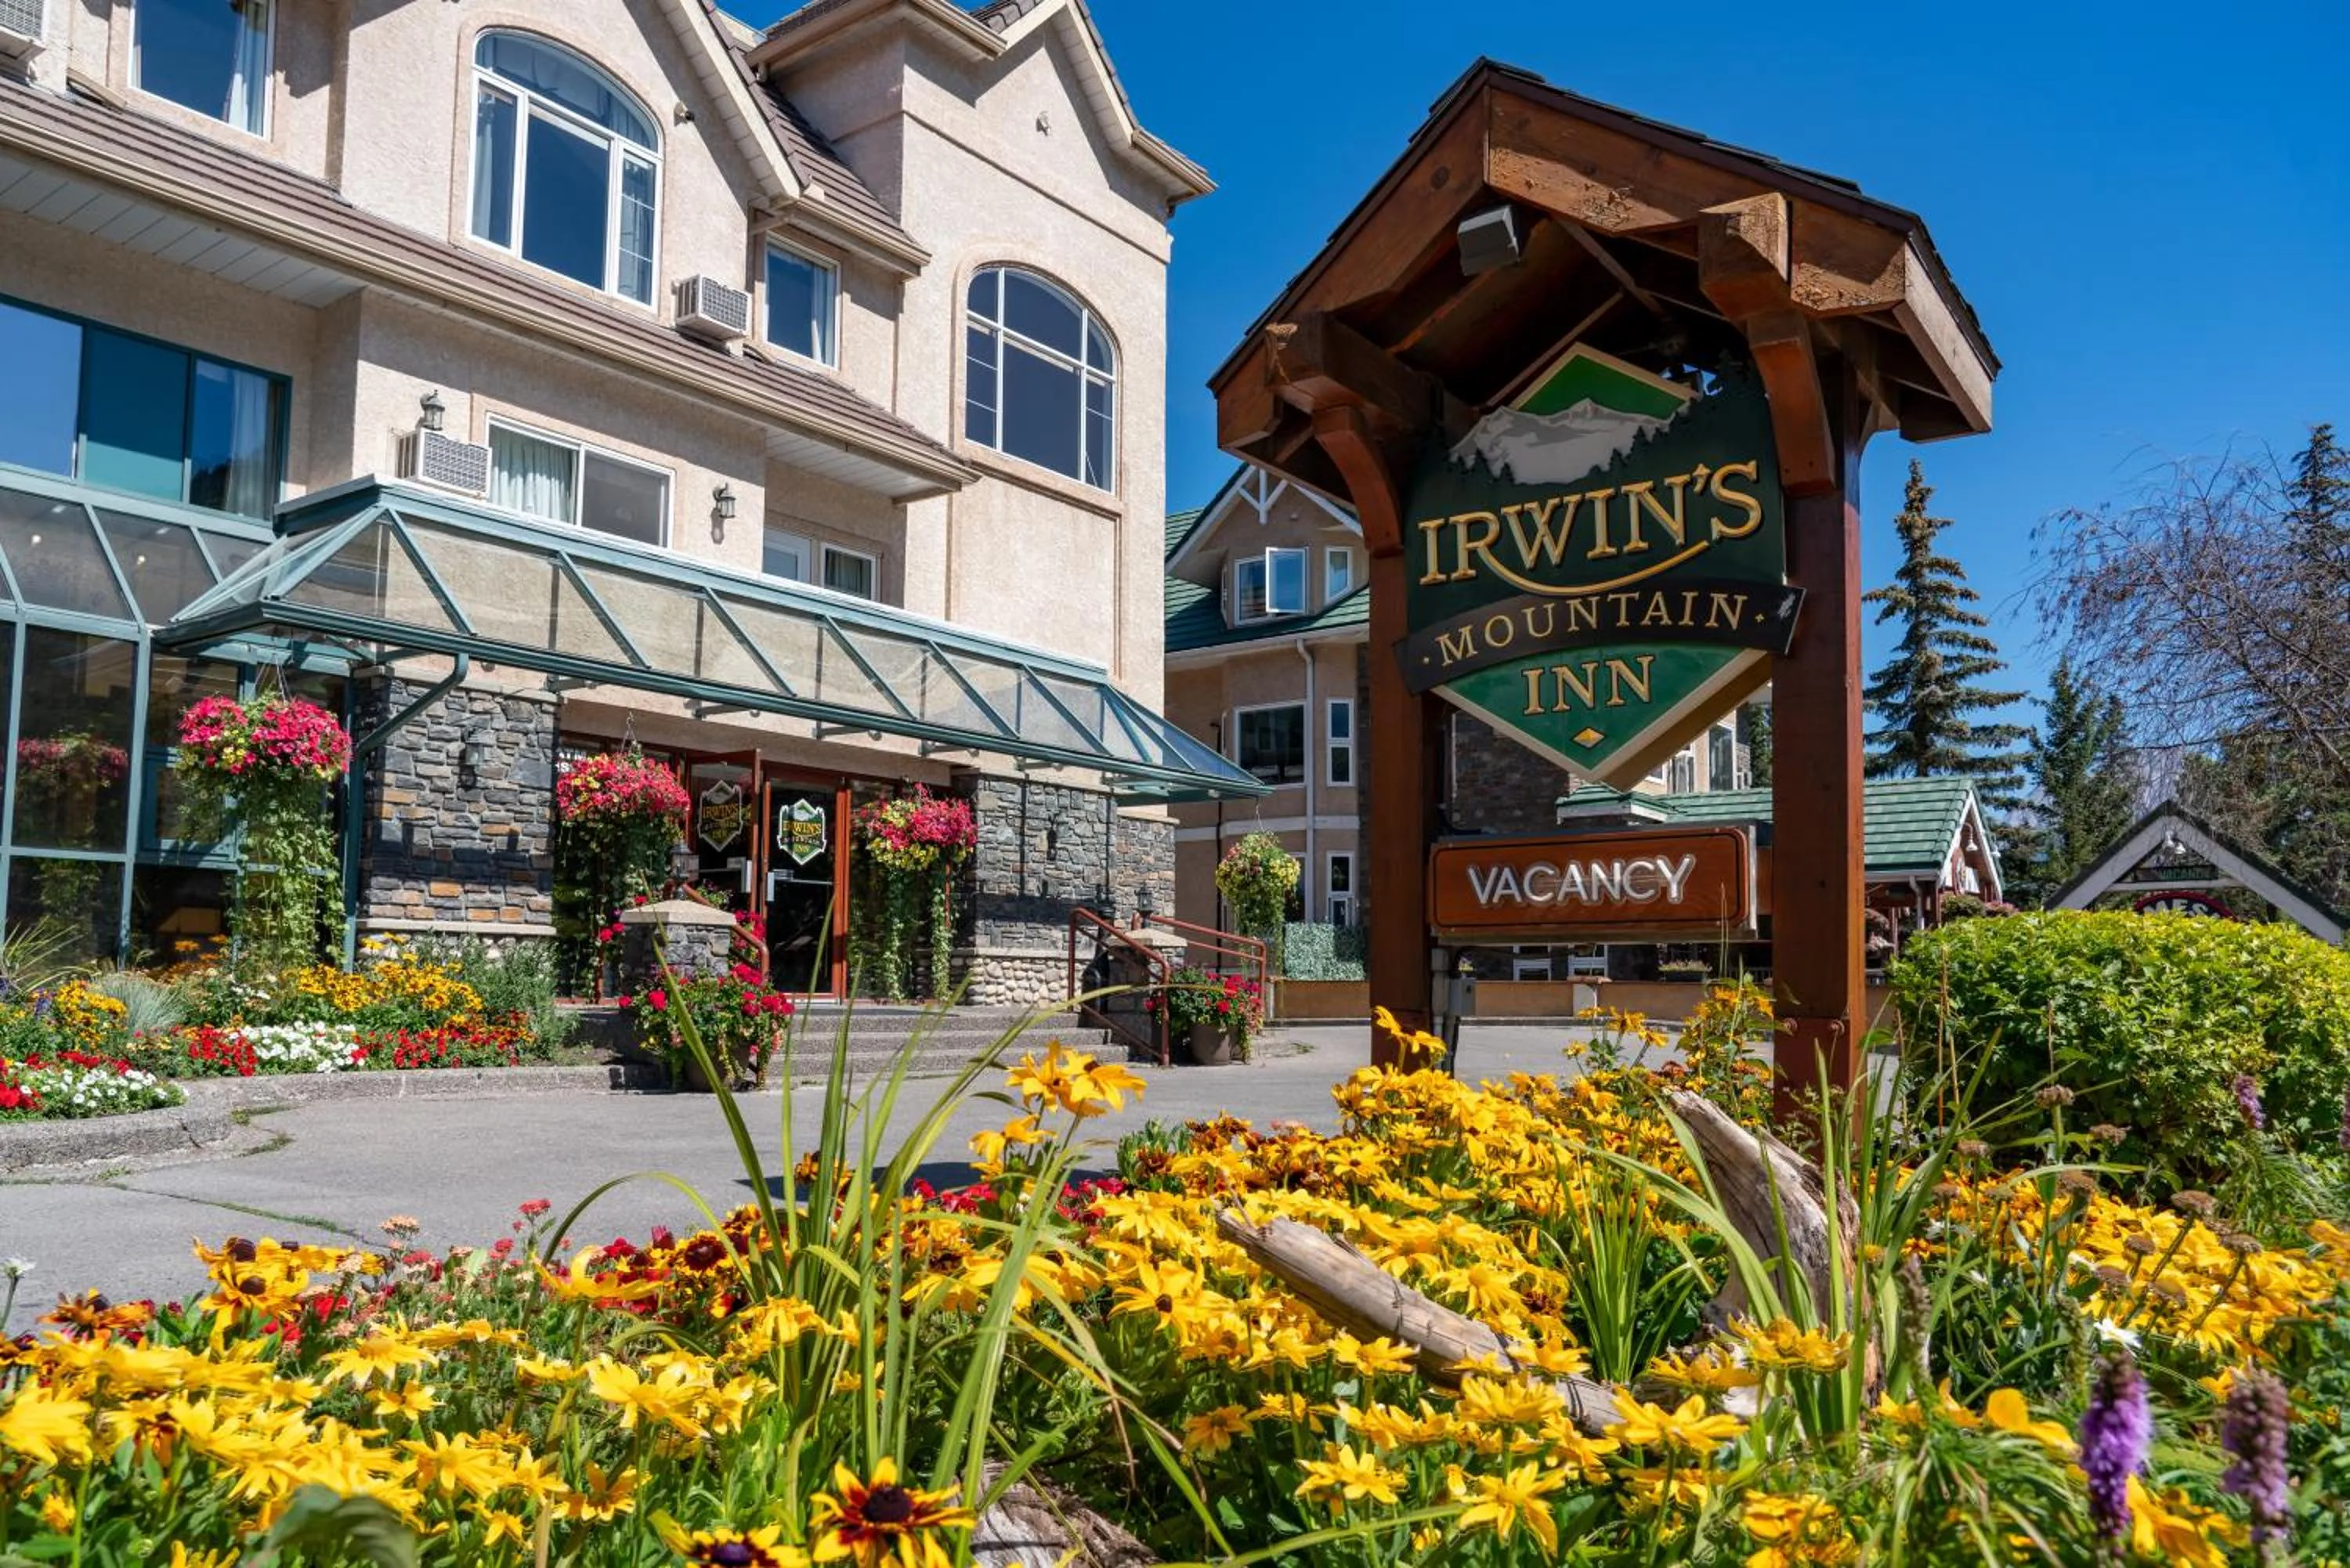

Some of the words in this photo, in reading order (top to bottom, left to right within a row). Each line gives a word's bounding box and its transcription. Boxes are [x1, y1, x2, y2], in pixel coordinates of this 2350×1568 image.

[1419, 459, 1762, 595] IRWIN'S
[1435, 591, 1748, 667] MOUNTAIN
[1521, 655, 1655, 716] INN
[1466, 853, 1695, 905] VACANCY
